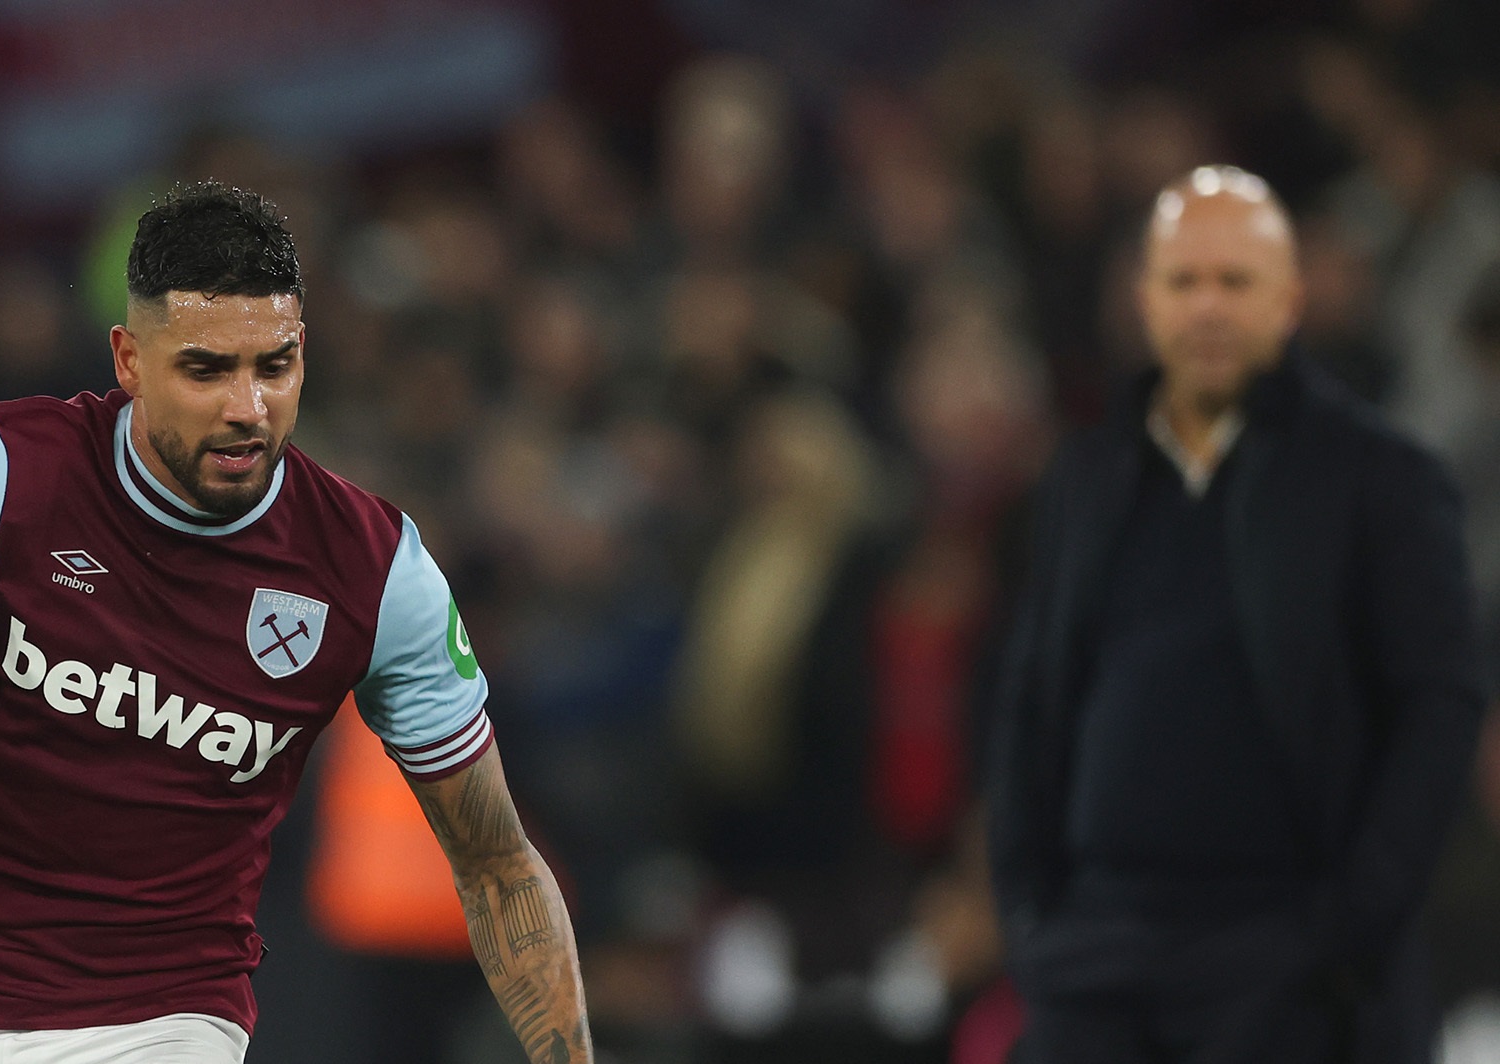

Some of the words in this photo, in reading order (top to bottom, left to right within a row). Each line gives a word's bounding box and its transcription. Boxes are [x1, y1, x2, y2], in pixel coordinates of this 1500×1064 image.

[51, 572, 95, 594] umbro
[263, 593, 293, 607] WEST
[293, 600, 320, 616] HAM
[272, 604, 307, 618] UNITED
[2, 615, 304, 784] betway
